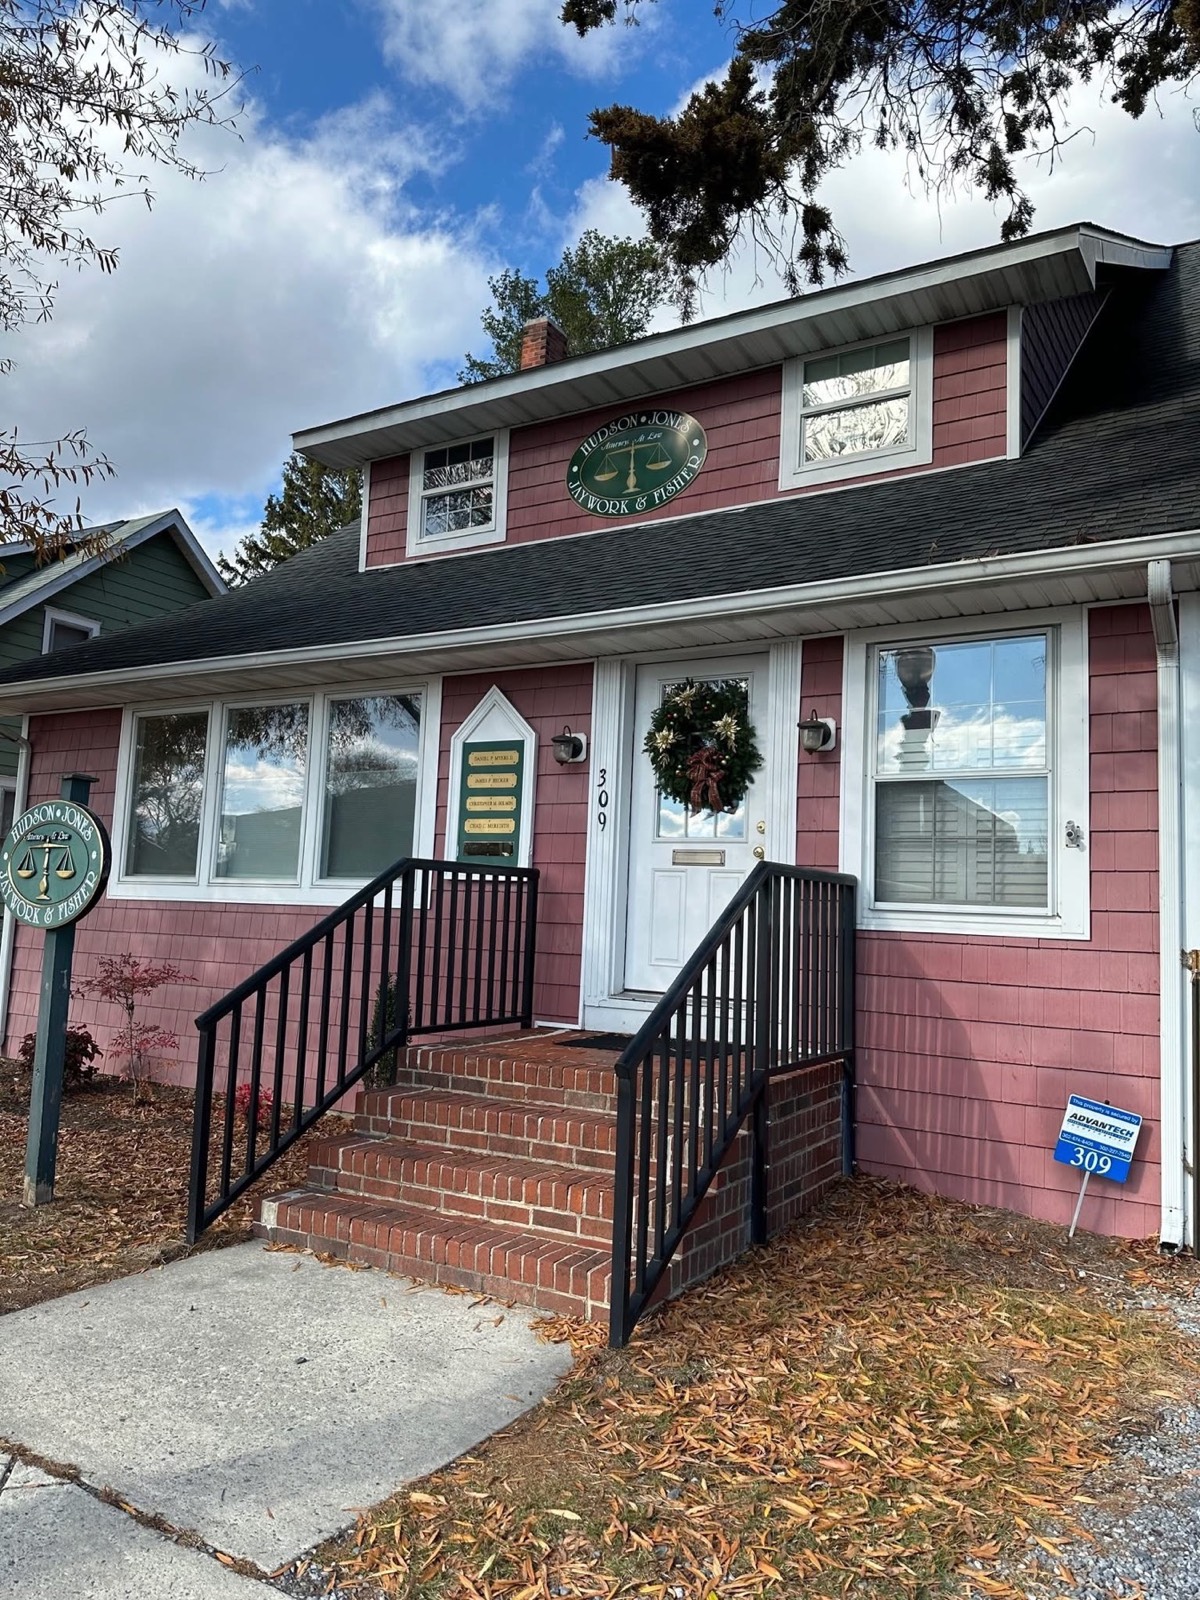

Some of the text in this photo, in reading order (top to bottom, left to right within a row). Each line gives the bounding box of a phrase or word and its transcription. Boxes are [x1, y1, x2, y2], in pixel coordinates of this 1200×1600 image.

[580, 411, 693, 456] HUDSON JONES
[647, 431, 663, 440] Law
[569, 455, 702, 514] JAYWORK & FISHER
[597, 768, 608, 832] 309
[11, 805, 94, 844] HUDSON JONES
[0, 870, 98, 924] JAYWORK & FISHER
[1069, 1112, 1134, 1138] ADVANTECH
[1072, 1098, 1083, 1106] This
[1083, 1102, 1104, 1113] property
[1110, 1110, 1131, 1121] secured
[1070, 1147, 1112, 1174] 309
